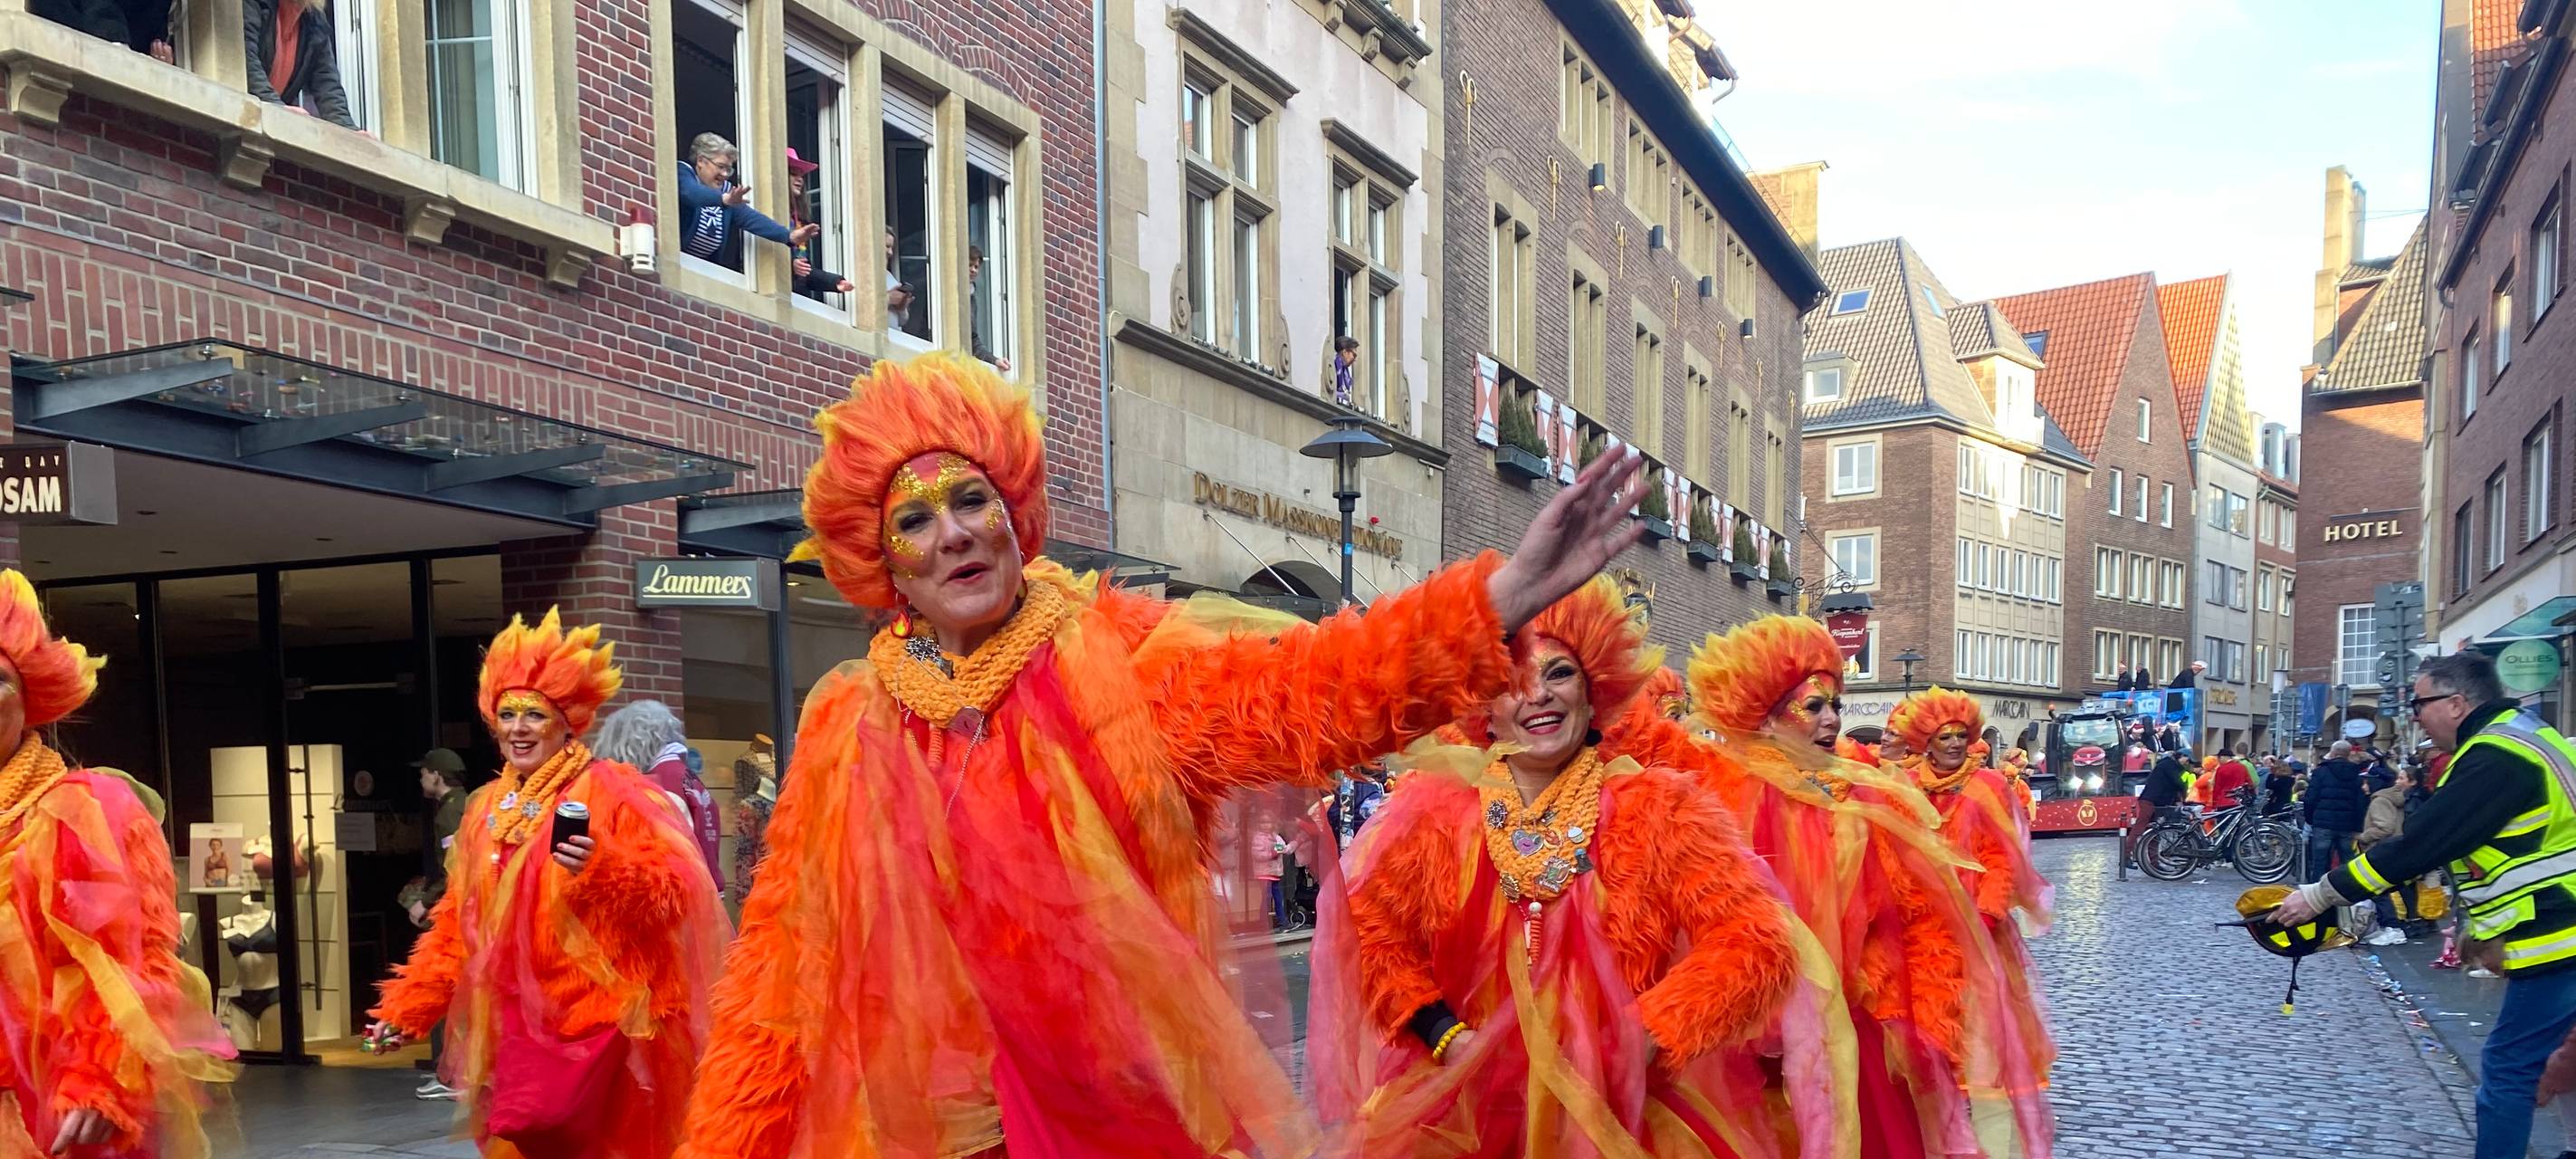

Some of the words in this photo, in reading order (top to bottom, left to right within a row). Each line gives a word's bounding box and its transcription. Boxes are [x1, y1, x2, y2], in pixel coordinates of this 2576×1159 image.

[0, 476, 62, 513] SAM
[2324, 520, 2403, 541] HOTEL
[642, 564, 752, 599] Lammers
[2505, 655, 2553, 665] OLLIES
